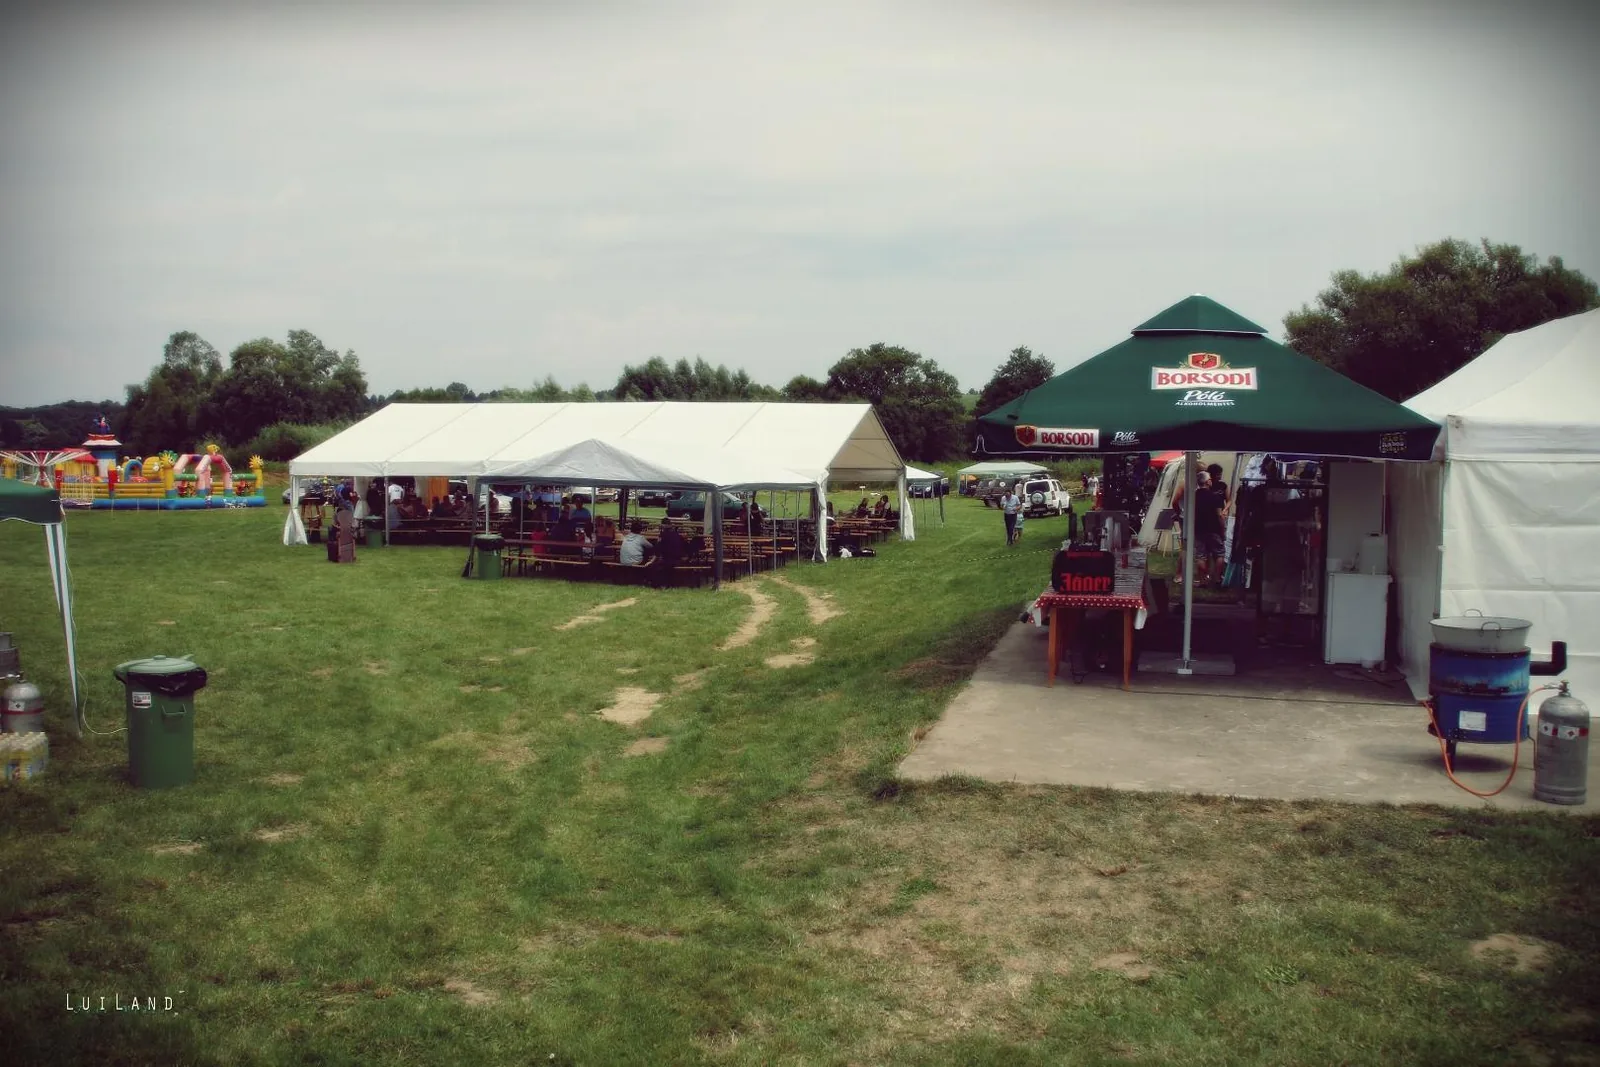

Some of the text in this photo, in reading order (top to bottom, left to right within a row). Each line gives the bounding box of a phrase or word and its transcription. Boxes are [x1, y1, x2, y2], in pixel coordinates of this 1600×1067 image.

[1157, 372, 1252, 386] BORSODI
[1183, 389, 1226, 401] Póló
[1041, 431, 1094, 446] BORSODI
[1114, 431, 1138, 441] Póló
